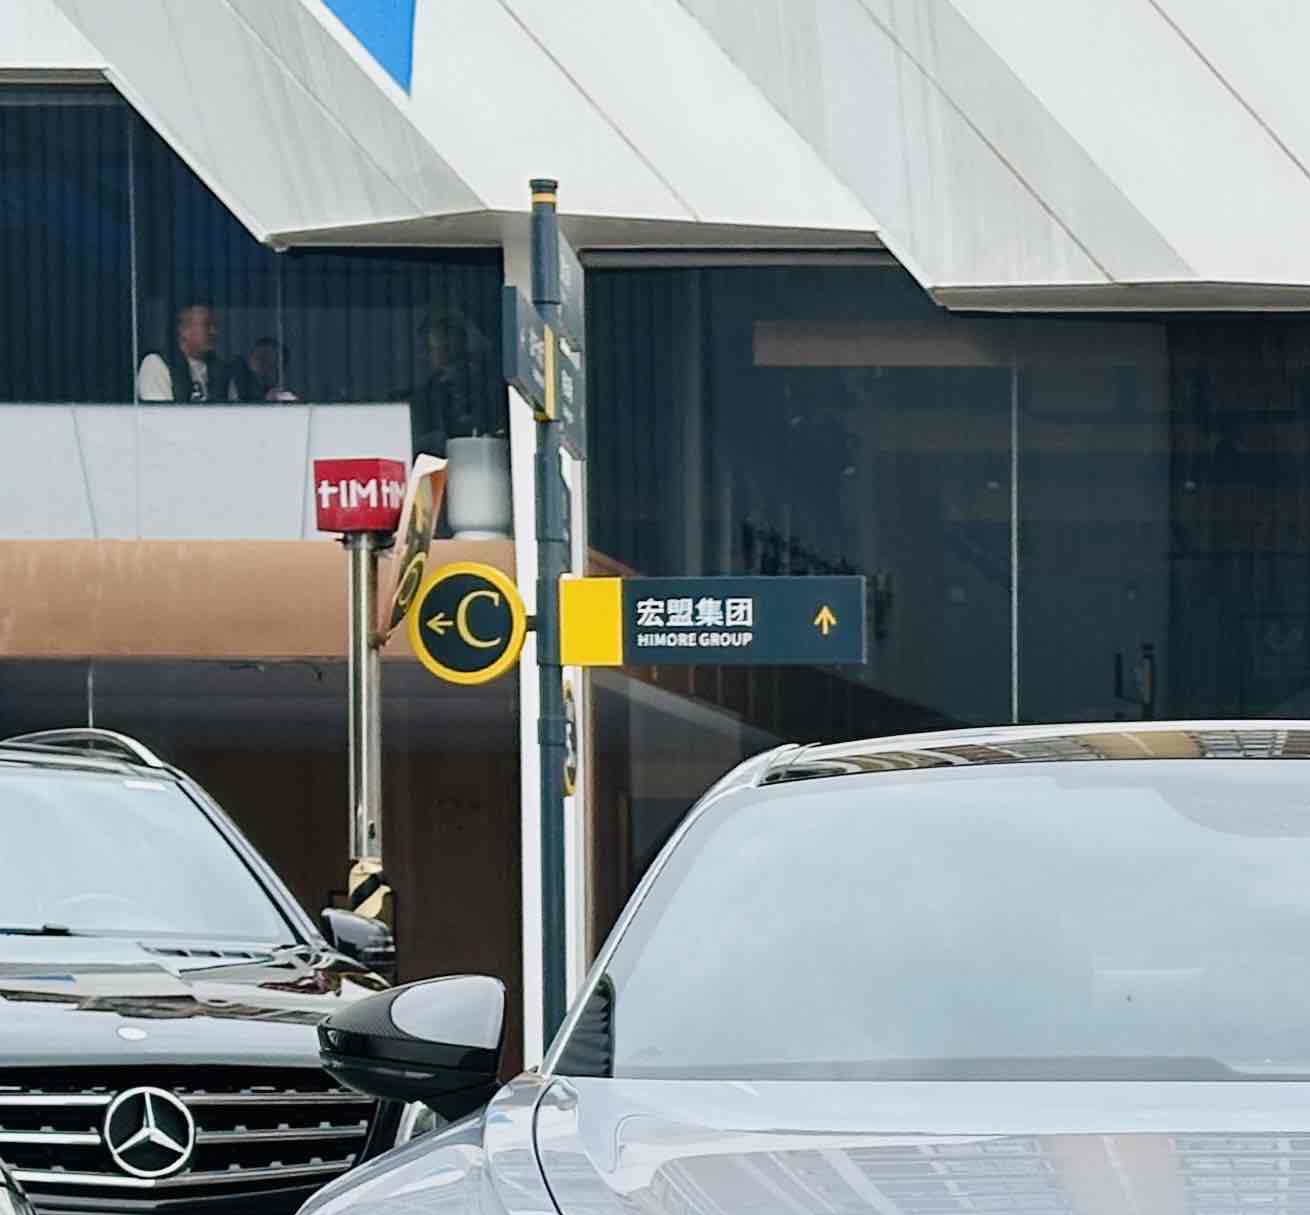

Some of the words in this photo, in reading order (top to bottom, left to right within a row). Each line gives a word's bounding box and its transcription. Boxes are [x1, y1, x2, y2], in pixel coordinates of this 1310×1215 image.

[457, 590, 501, 648] C
[636, 598, 753, 627] 宏盟集团
[637, 633, 697, 647] HIMORE
[698, 632, 753, 647] GROUP
